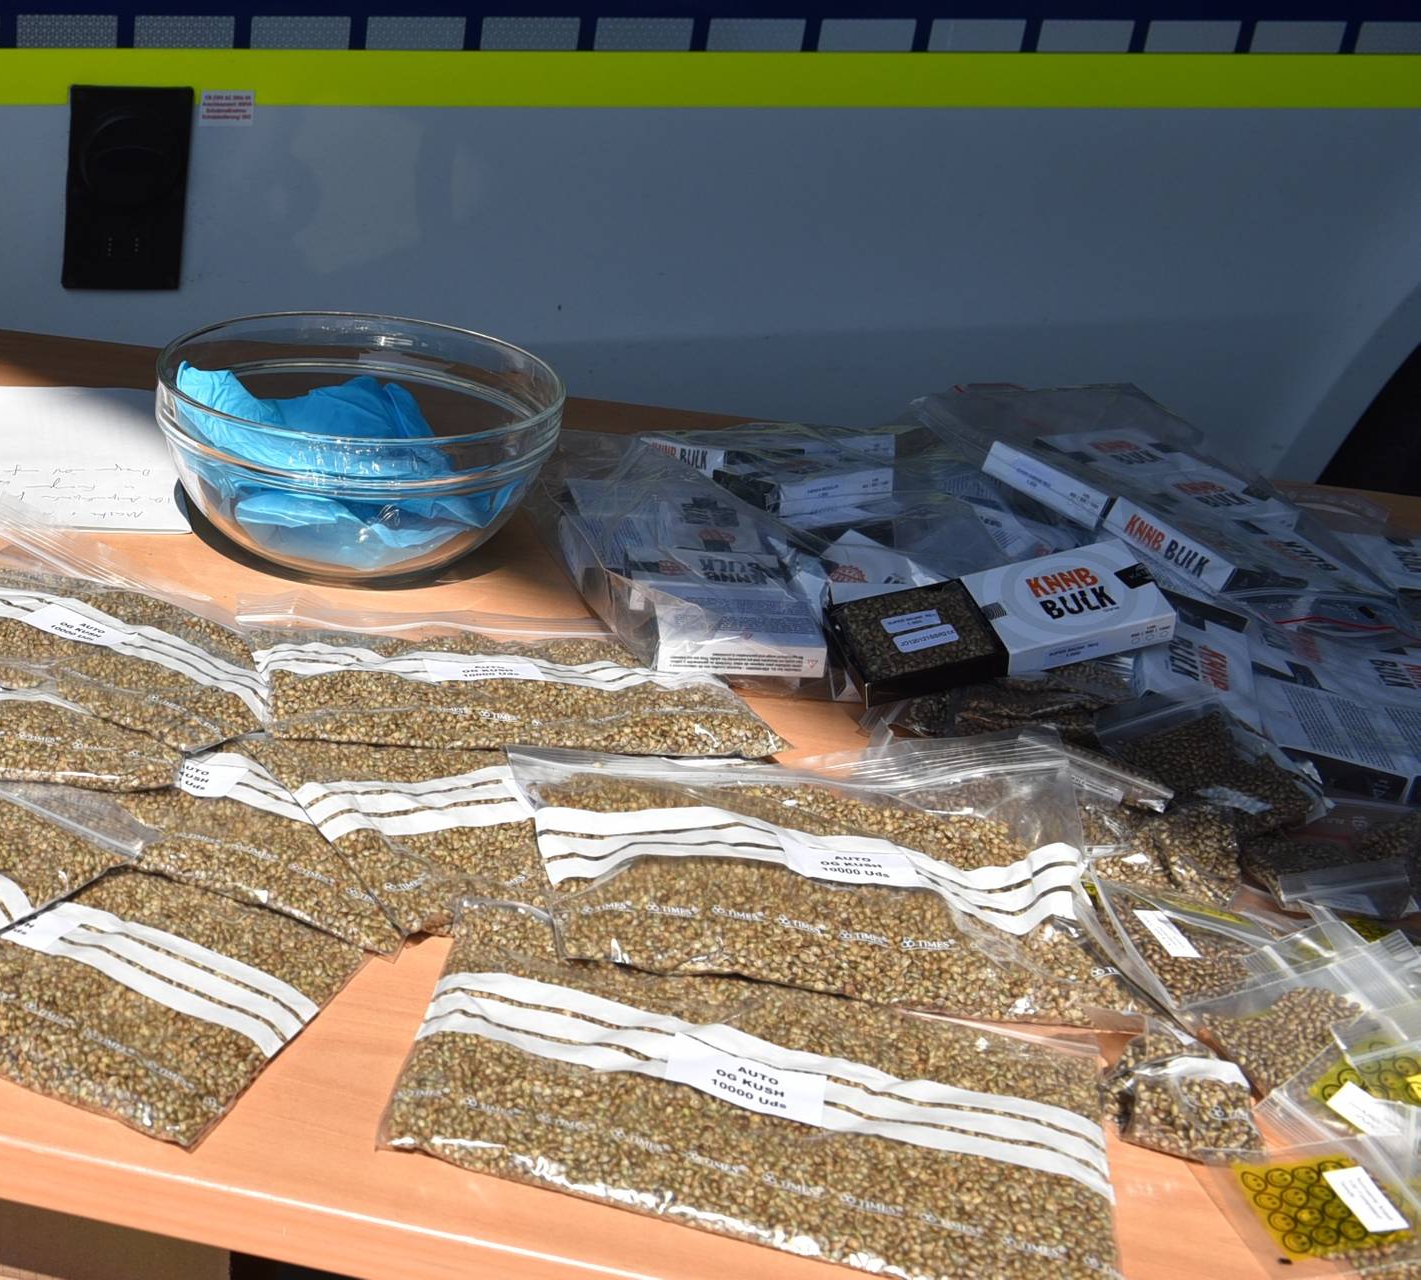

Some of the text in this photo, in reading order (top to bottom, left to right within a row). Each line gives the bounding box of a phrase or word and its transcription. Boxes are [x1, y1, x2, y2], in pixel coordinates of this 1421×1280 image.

[679, 447, 708, 470] BULK
[1124, 513, 1211, 579] KNNB BULK
[1025, 566, 1100, 599] KNNB
[1039, 585, 1118, 621] BULK
[59, 621, 75, 630] OG
[79, 621, 106, 634] AUTO
[822, 867, 890, 878] 10000 Uds
[716, 1068, 785, 1098] OG KUSH
[737, 1066, 779, 1085] AUTO
[710, 1078, 787, 1109] 10000 Uds
